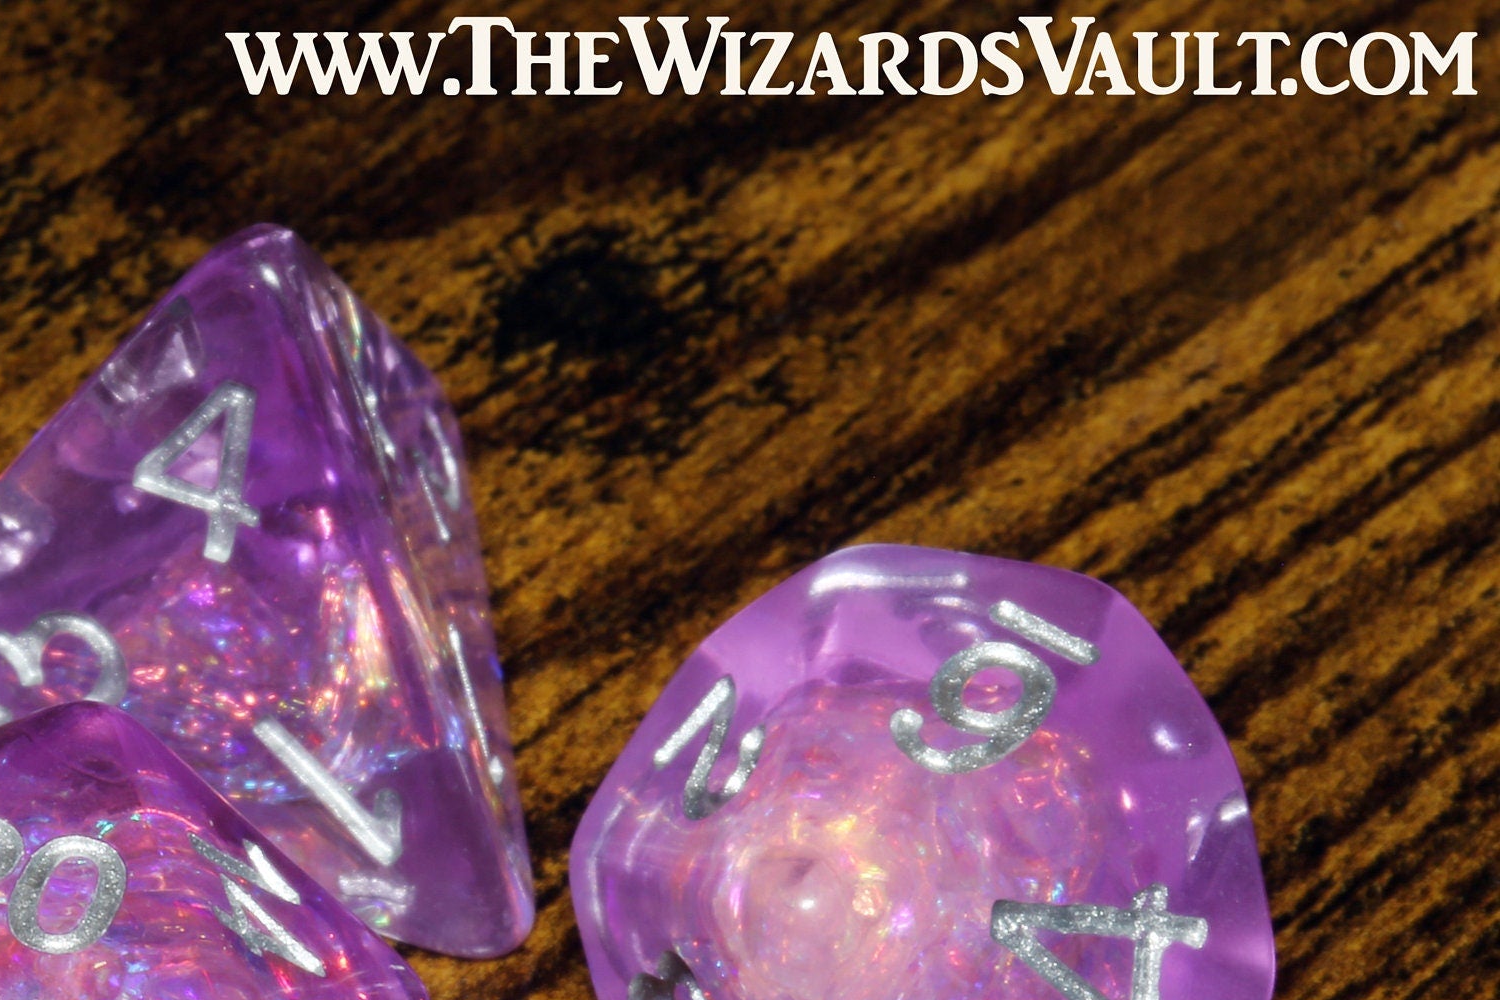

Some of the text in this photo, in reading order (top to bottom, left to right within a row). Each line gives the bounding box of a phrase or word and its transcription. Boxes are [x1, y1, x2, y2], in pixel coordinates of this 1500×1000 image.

[132, 380, 258, 563] 4
[253, 716, 403, 865] 1
[654, 674, 765, 820] 2
